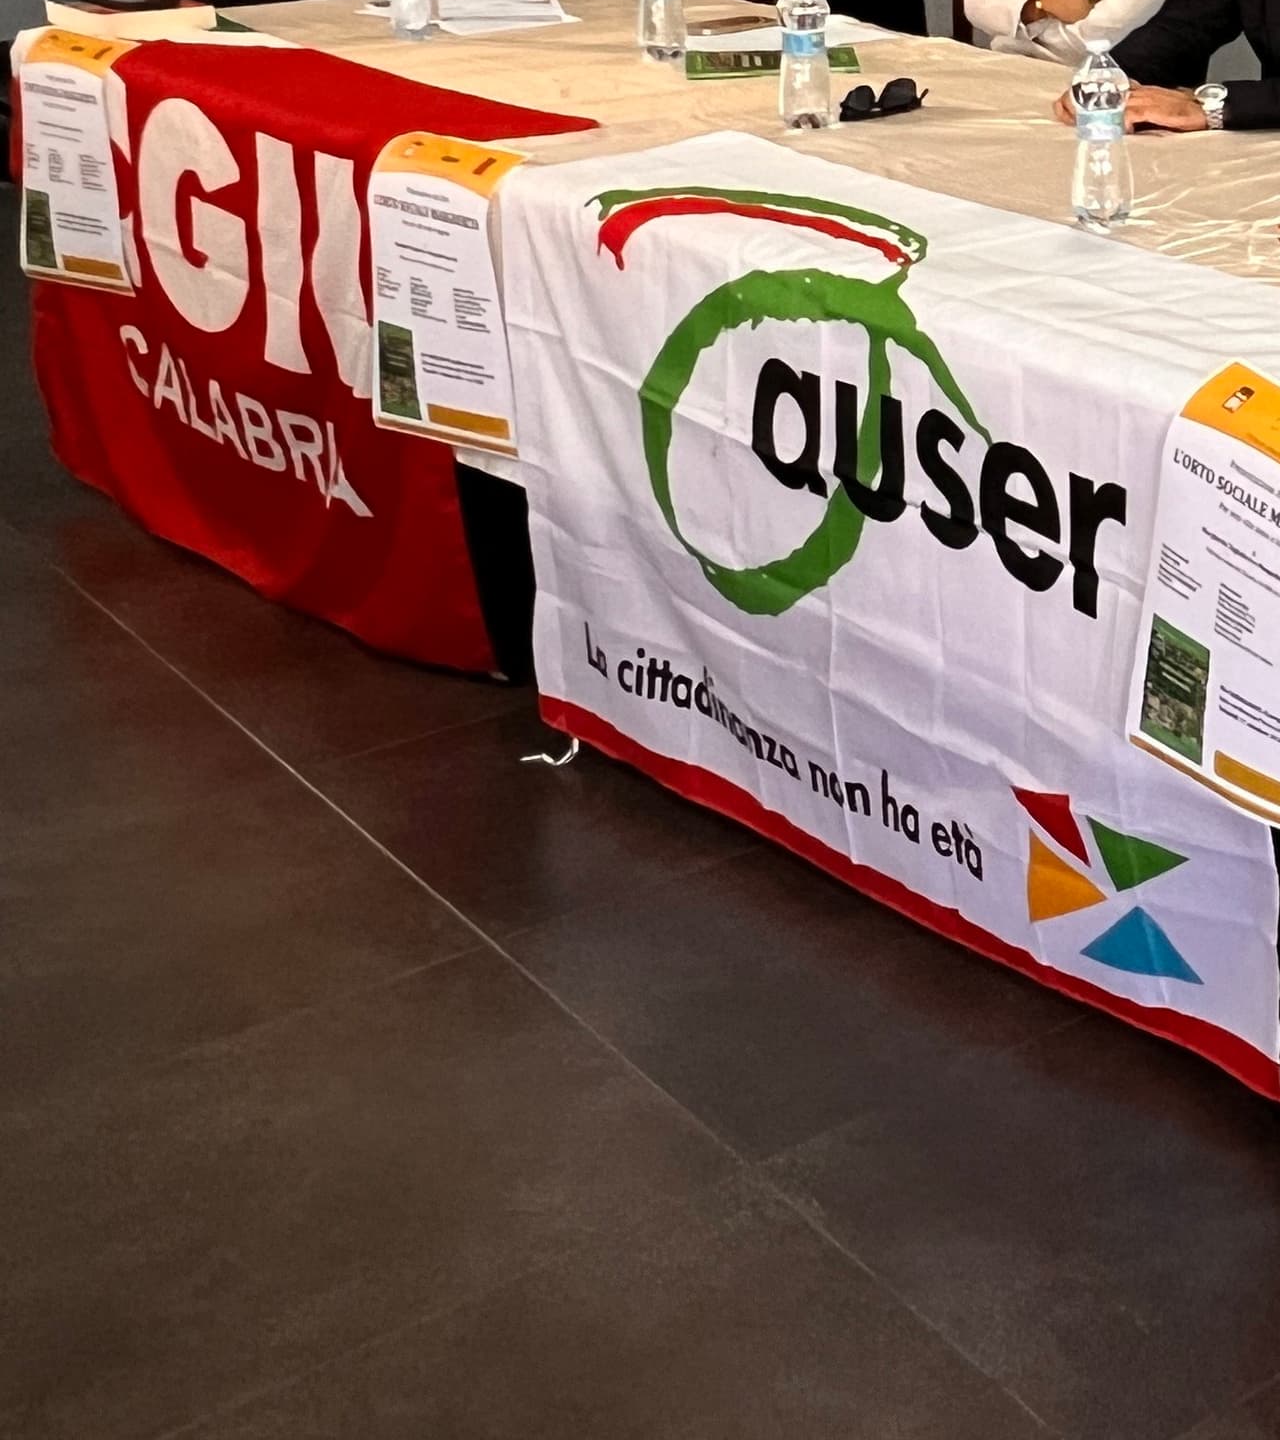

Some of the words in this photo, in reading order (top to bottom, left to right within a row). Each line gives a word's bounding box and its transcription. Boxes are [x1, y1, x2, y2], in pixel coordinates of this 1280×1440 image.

[752, 358, 1127, 620] auser
[617, 648, 802, 781] cittadinanza
[808, 760, 872, 817] non
[881, 768, 921, 845] ha
[931, 819, 984, 882] età
